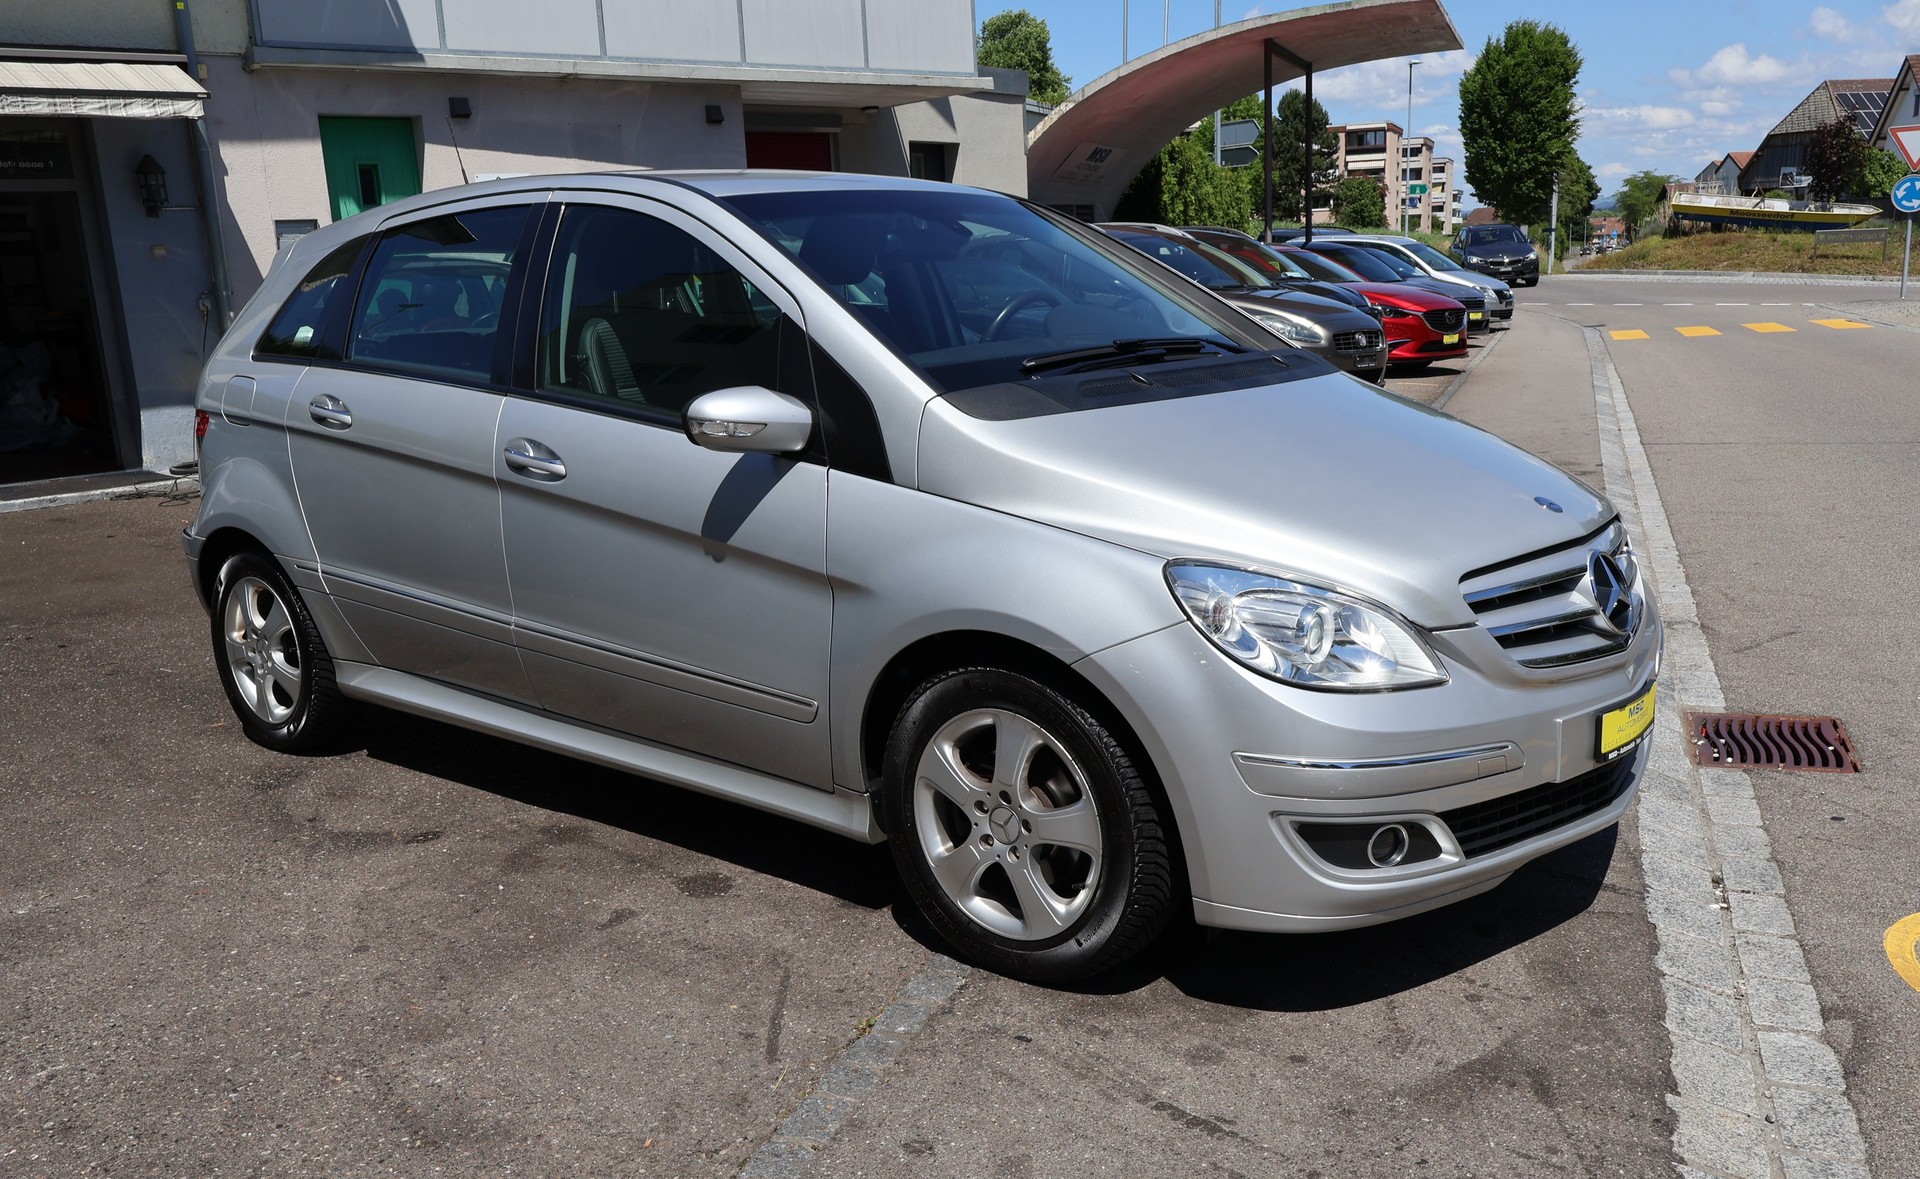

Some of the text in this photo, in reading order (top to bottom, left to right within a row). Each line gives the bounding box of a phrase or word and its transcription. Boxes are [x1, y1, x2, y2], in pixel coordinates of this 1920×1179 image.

[1086, 146, 1113, 163] MSD
[48, 160, 54, 168] 1
[1729, 210, 1796, 220] Moosseedorf
[1628, 700, 1645, 718] MSD
